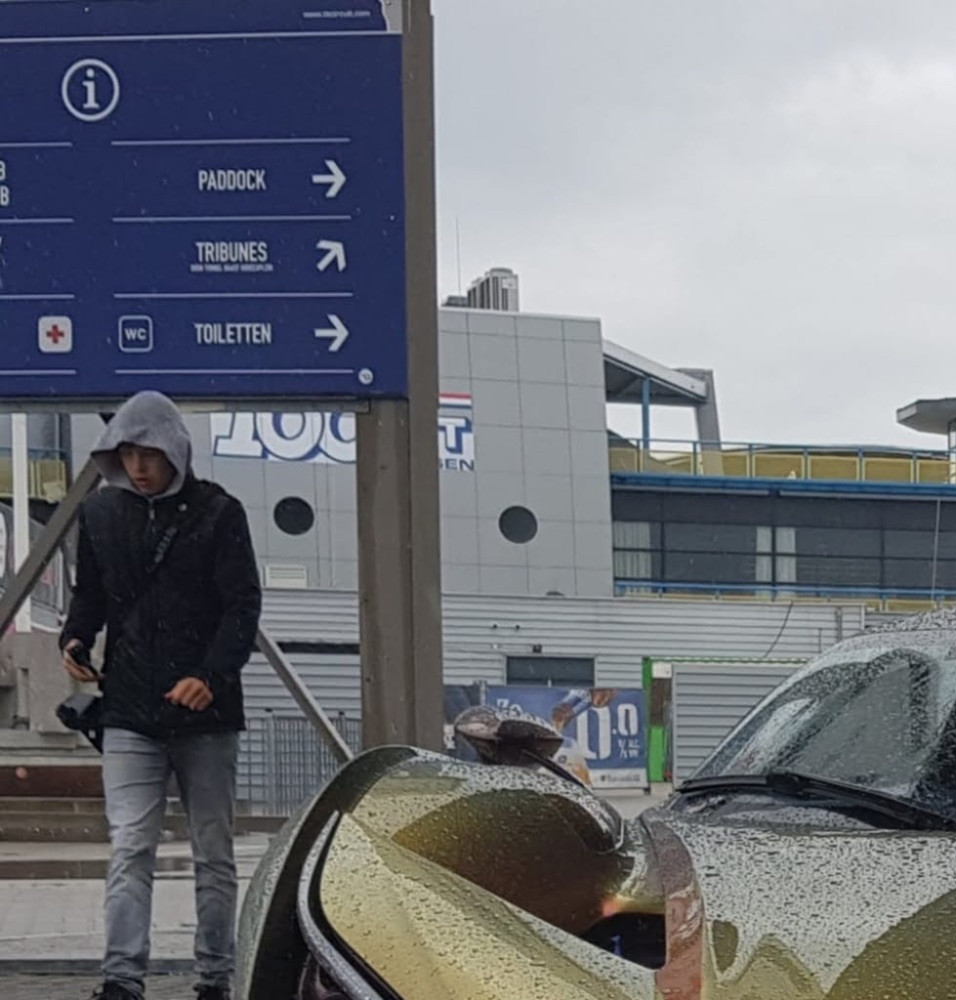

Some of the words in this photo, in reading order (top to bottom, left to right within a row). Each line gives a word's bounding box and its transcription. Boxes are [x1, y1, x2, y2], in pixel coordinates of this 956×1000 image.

[198, 169, 267, 191] PADDOCK
[195, 241, 268, 262] TRIBUNES
[124, 327, 147, 341] WC
[194, 322, 272, 345] TOILETTEN
